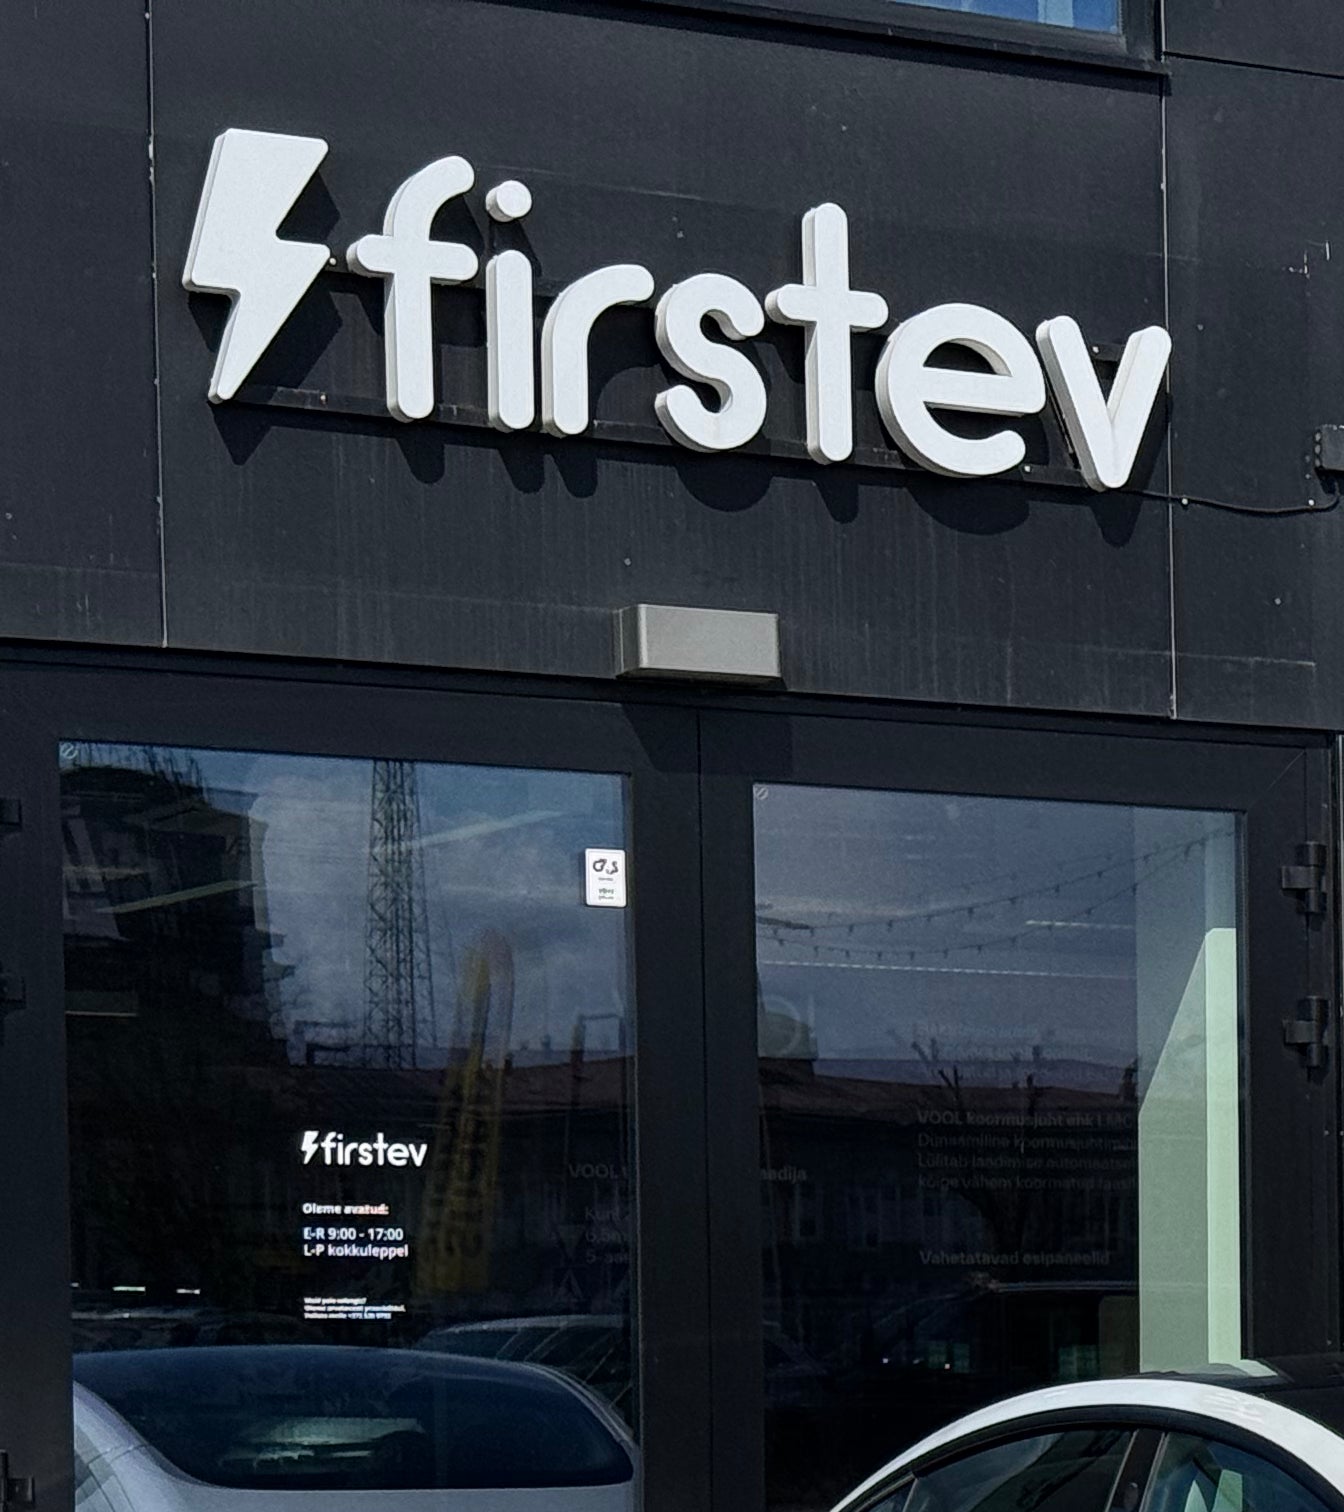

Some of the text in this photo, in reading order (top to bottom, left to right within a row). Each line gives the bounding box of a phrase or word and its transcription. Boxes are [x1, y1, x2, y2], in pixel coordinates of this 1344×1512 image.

[346, 154, 1172, 490] firstev
[321, 1131, 428, 1167] firstev
[327, 1228, 357, 1241] 9:00
[368, 1228, 404, 1241] 17:00
[327, 1244, 409, 1260] kokkuleppel
